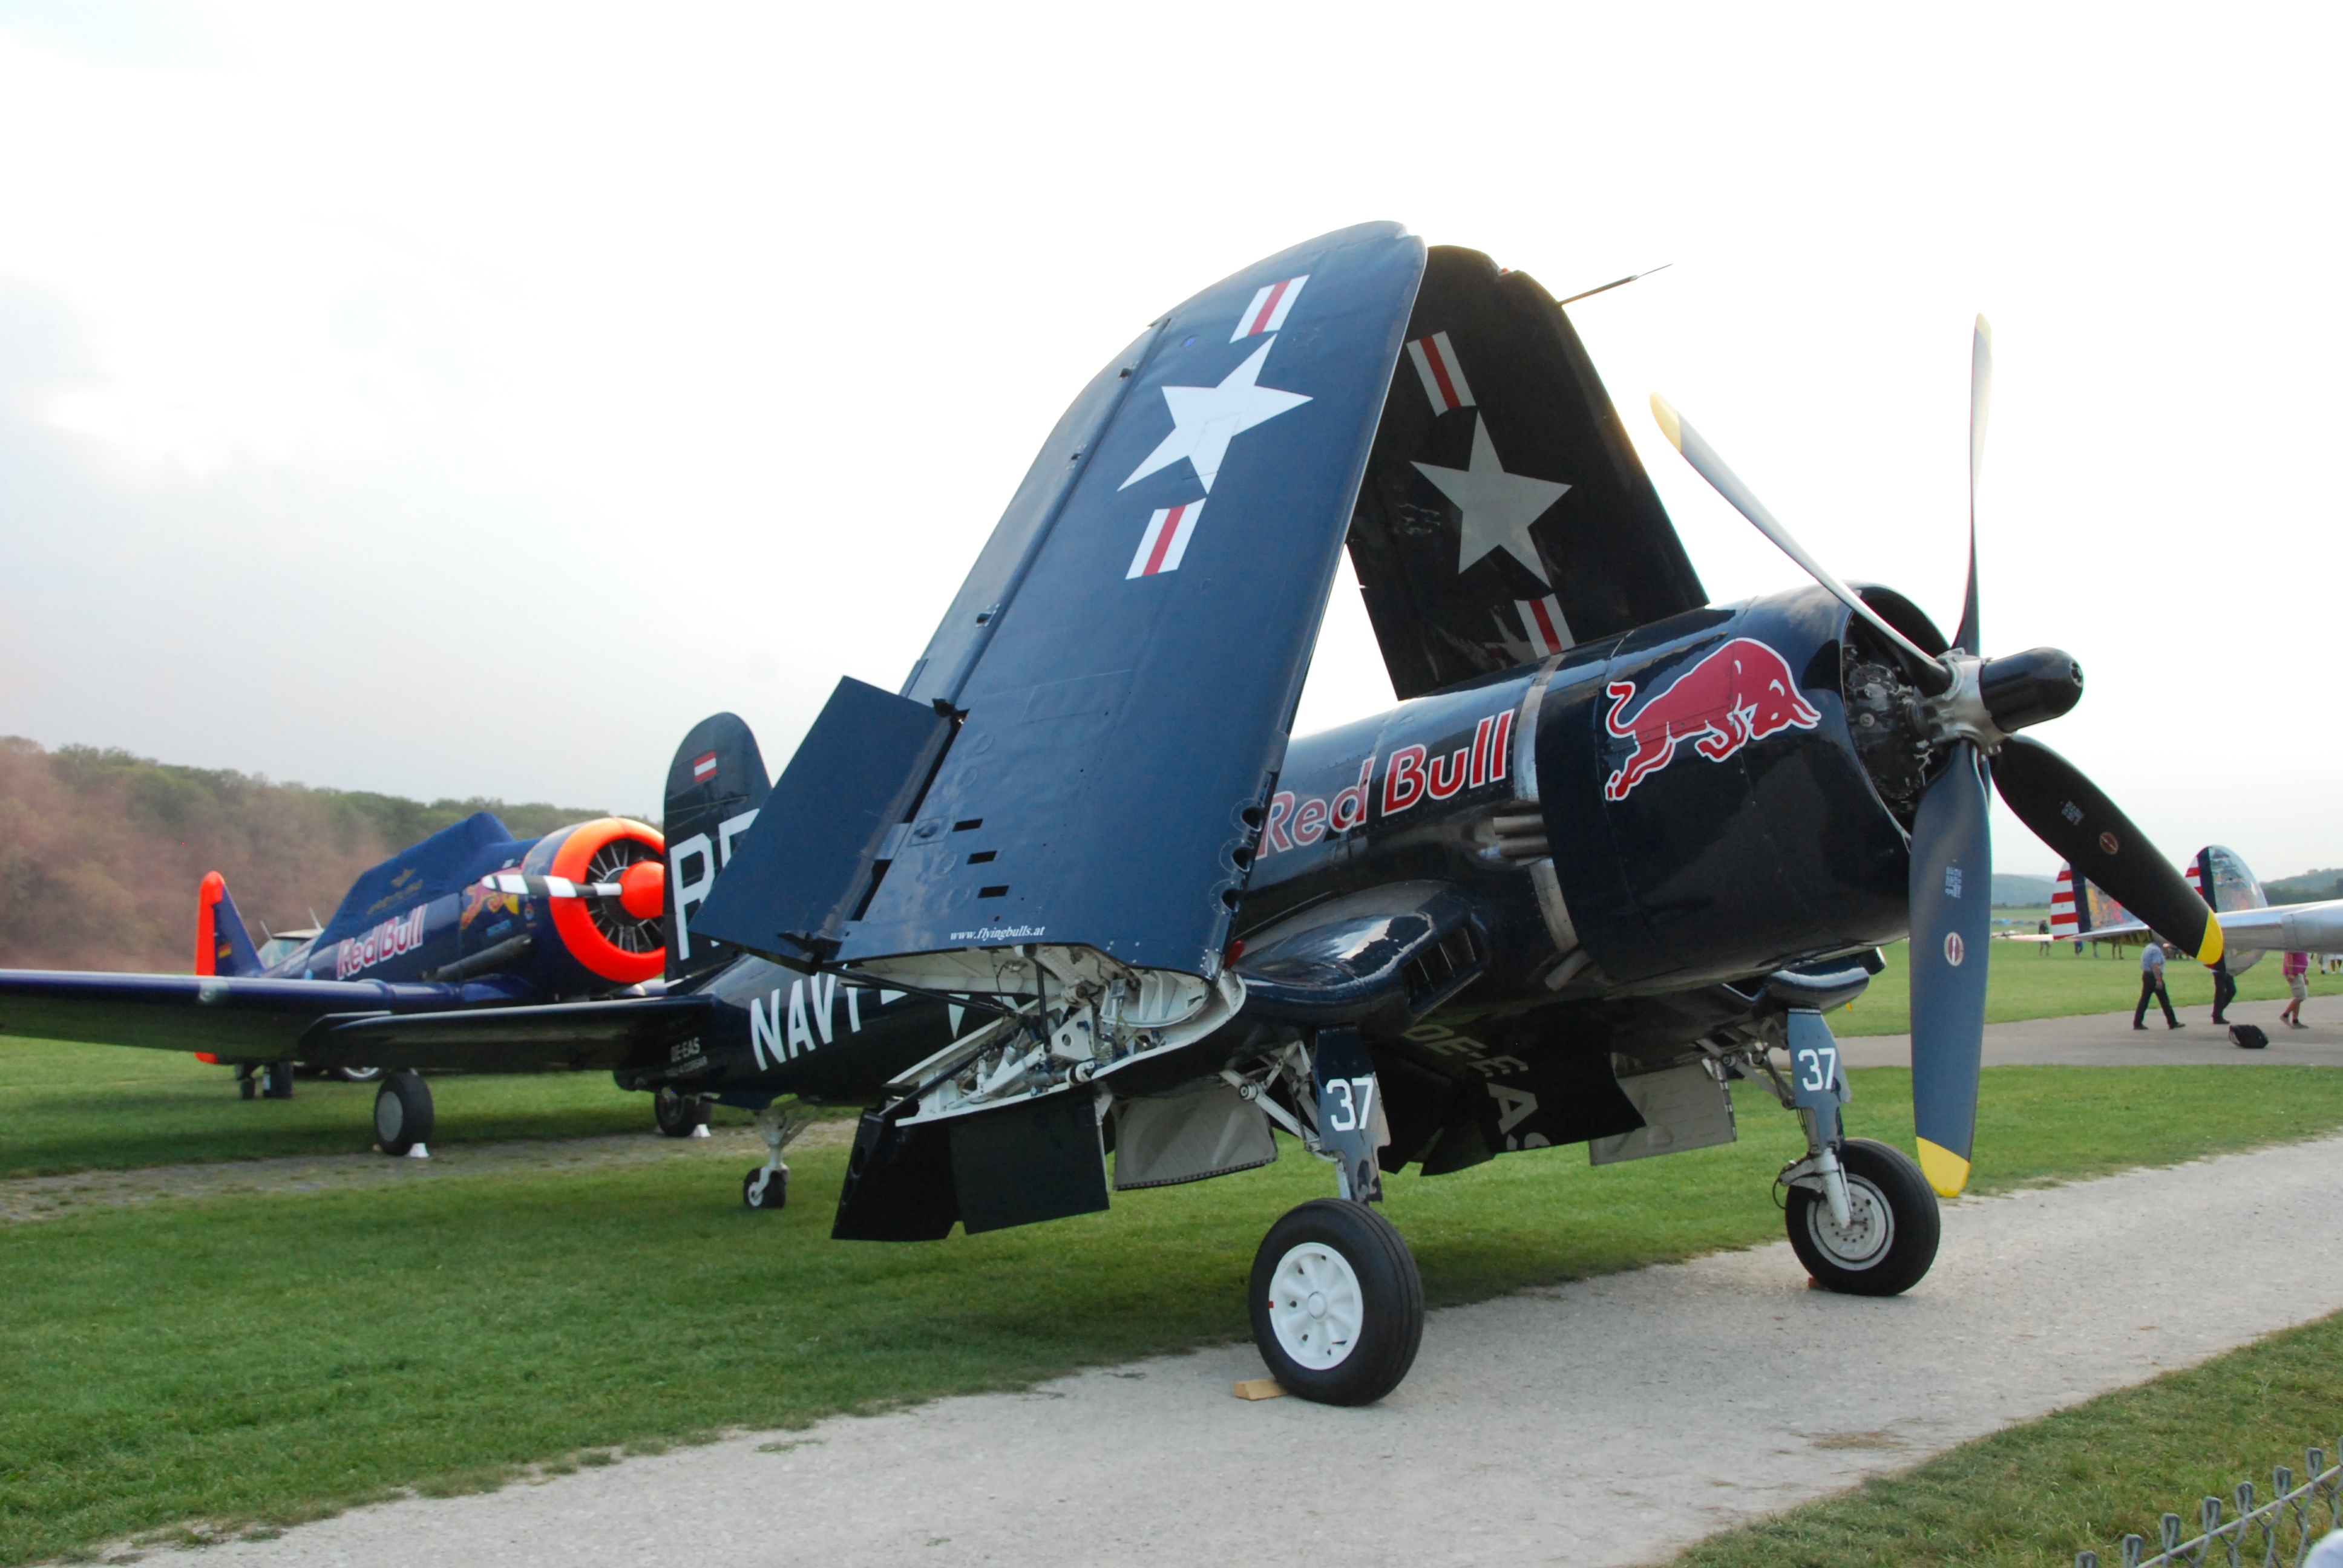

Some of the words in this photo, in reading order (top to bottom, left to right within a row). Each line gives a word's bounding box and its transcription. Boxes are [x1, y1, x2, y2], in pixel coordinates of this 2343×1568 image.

[1256, 756, 1376, 860] Red
[1381, 708, 1515, 817] Bull
[337, 924, 381, 981] Red
[379, 903, 428, 962] Bull
[950, 925, 1046, 941] www.flyingbulls.at
[1798, 1048, 1836, 1091] 37
[1326, 1077, 1374, 1131] 37
